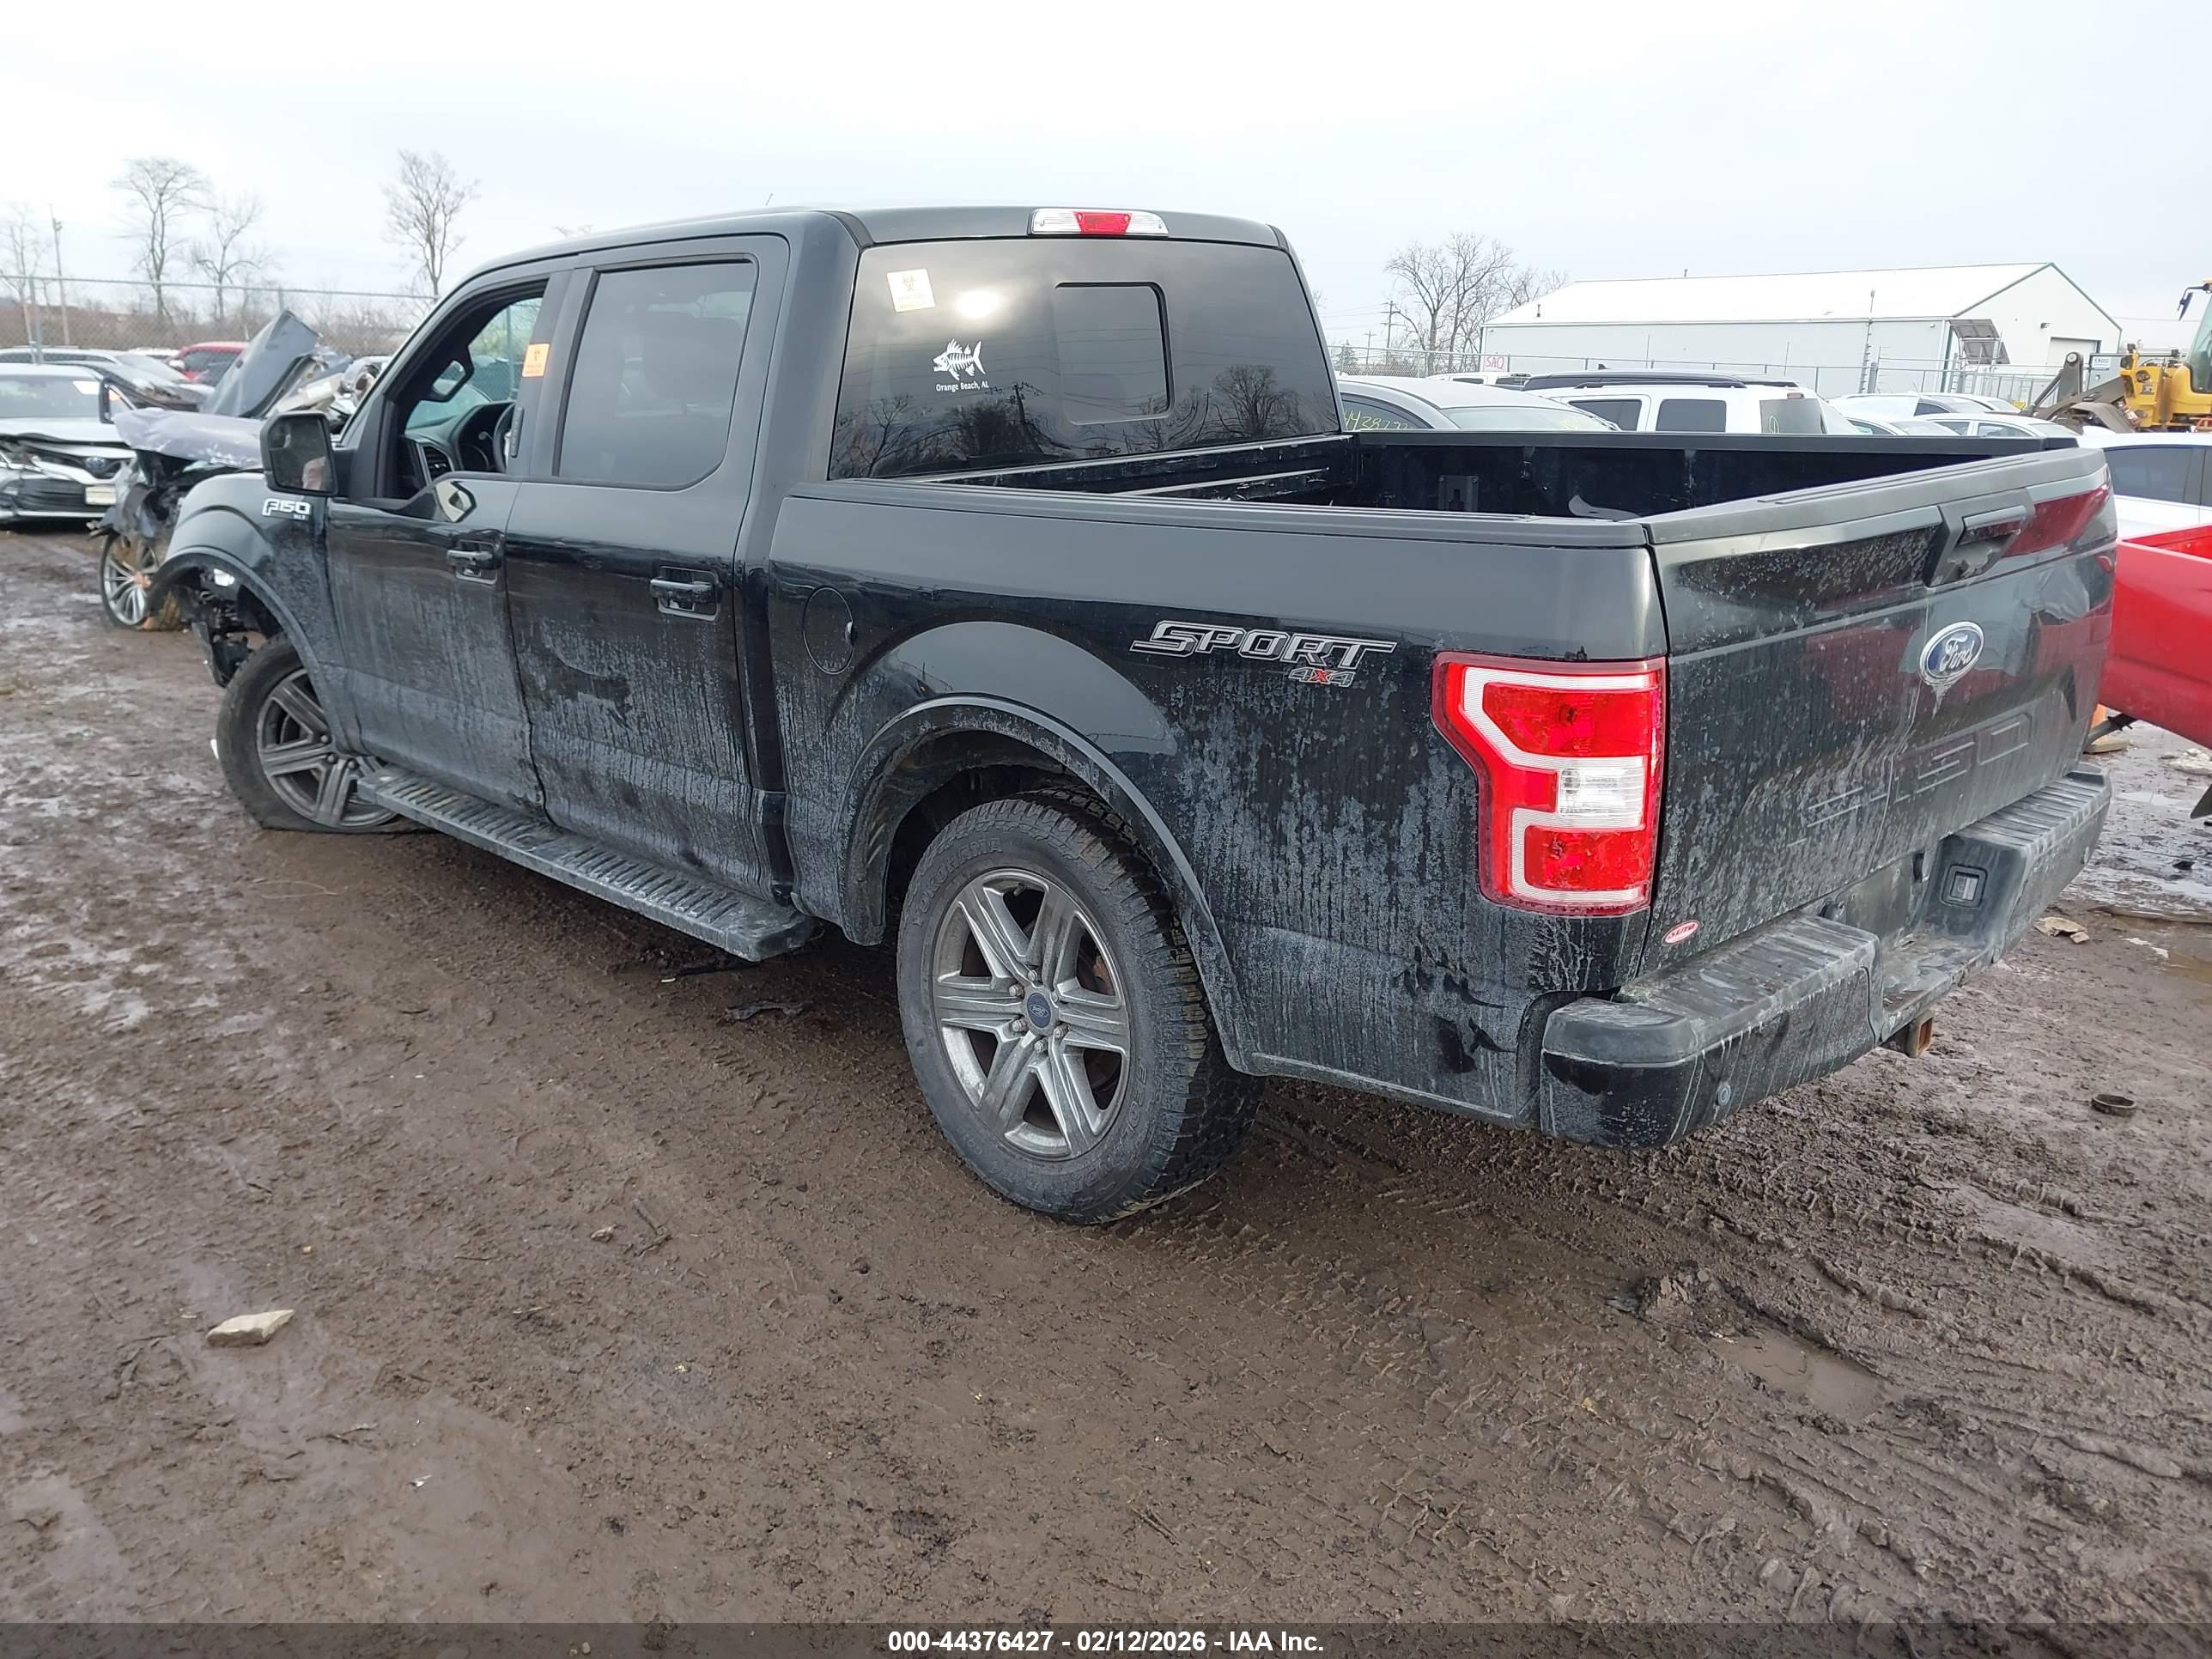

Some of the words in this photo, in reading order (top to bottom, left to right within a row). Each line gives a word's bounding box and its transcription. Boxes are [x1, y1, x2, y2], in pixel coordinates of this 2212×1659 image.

[935, 383, 959, 393] Orange
[960, 380, 981, 391] Beach,
[981, 380, 990, 388] AL
[1129, 619, 1398, 670] SPORT
[911, 837, 1004, 929] YOKOHAMA
